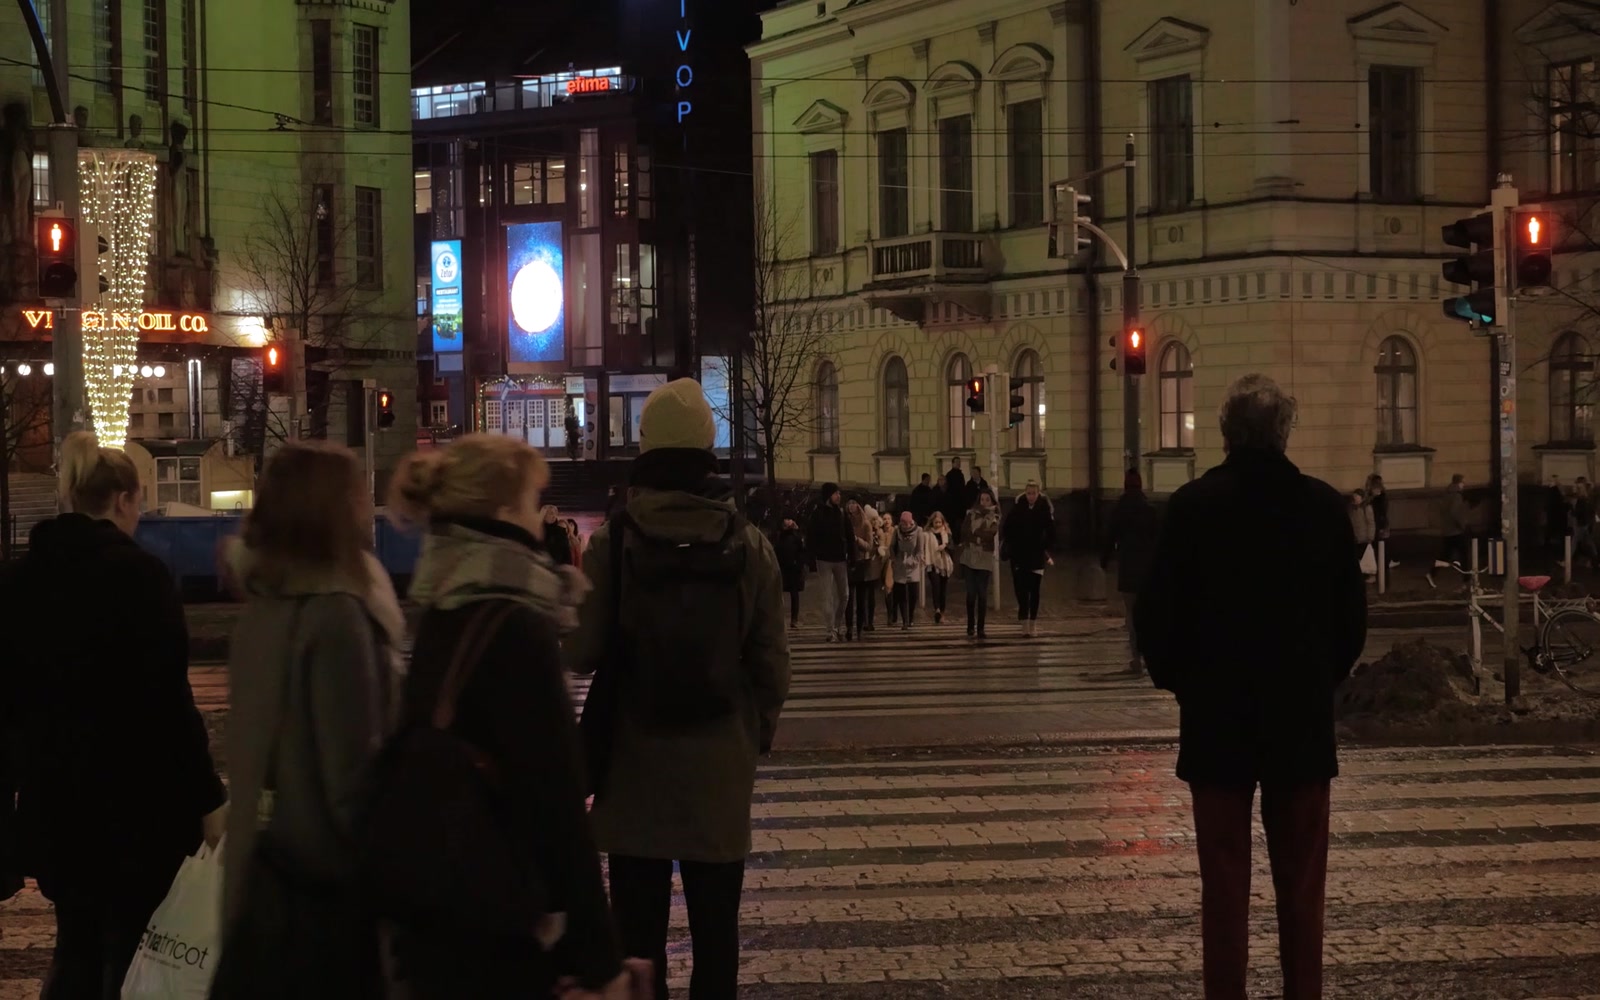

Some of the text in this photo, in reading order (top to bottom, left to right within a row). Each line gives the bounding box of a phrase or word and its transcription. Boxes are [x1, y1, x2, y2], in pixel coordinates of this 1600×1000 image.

[566, 76, 610, 94] efima
[22, 311, 209, 333] VIGIN OIL CO.
